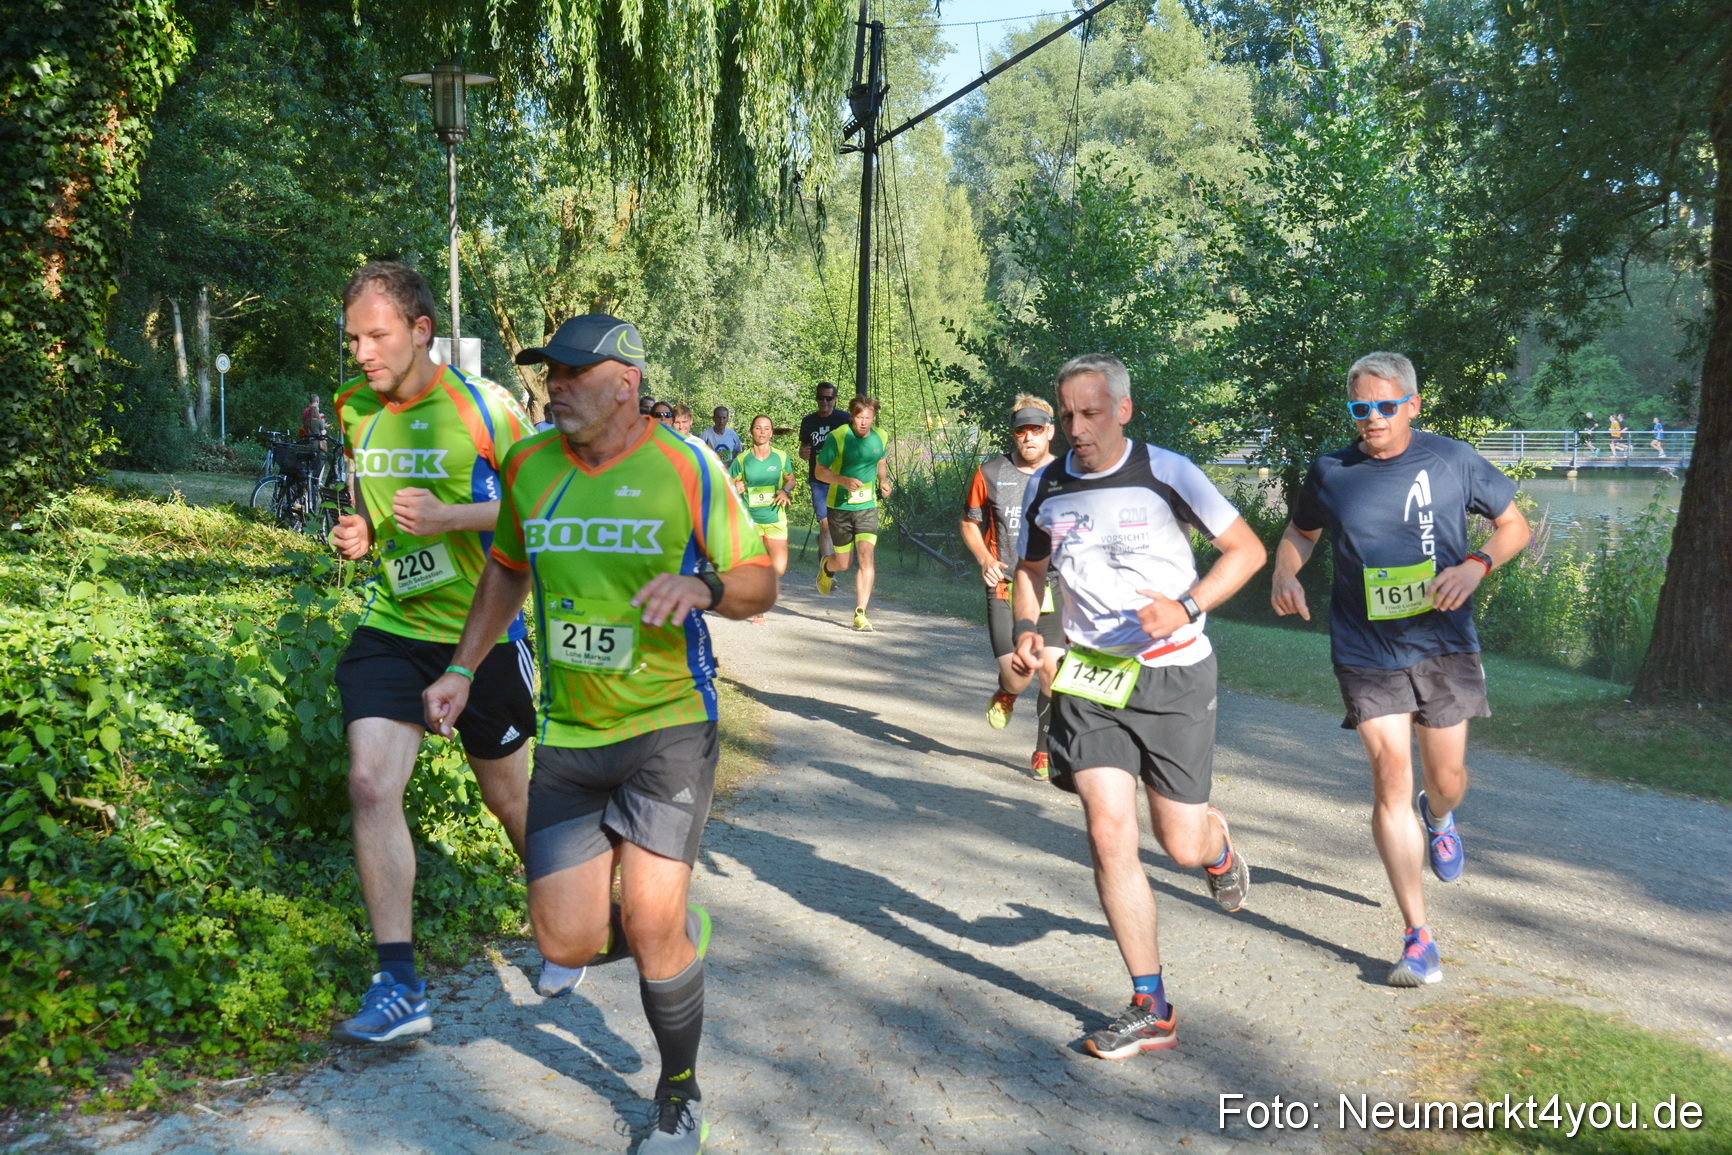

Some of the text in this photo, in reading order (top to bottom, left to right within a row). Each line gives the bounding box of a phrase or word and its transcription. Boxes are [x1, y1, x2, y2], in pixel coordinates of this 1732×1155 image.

[354, 448, 449, 479] BOCK
[758, 493, 765, 501] 9
[858, 490, 864, 498] 6
[1004, 506, 1022, 517] HE
[1009, 517, 1021, 529] D
[524, 517, 664, 555] BOCK
[1101, 531, 1149, 544] VORSICHT!
[394, 549, 436, 581] 220
[413, 569, 444, 583] Sebastian
[1375, 581, 1426, 605] 1611
[562, 623, 615, 653] 215
[565, 650, 611, 661] Lohe Markus
[1073, 661, 1124, 690] 1471
